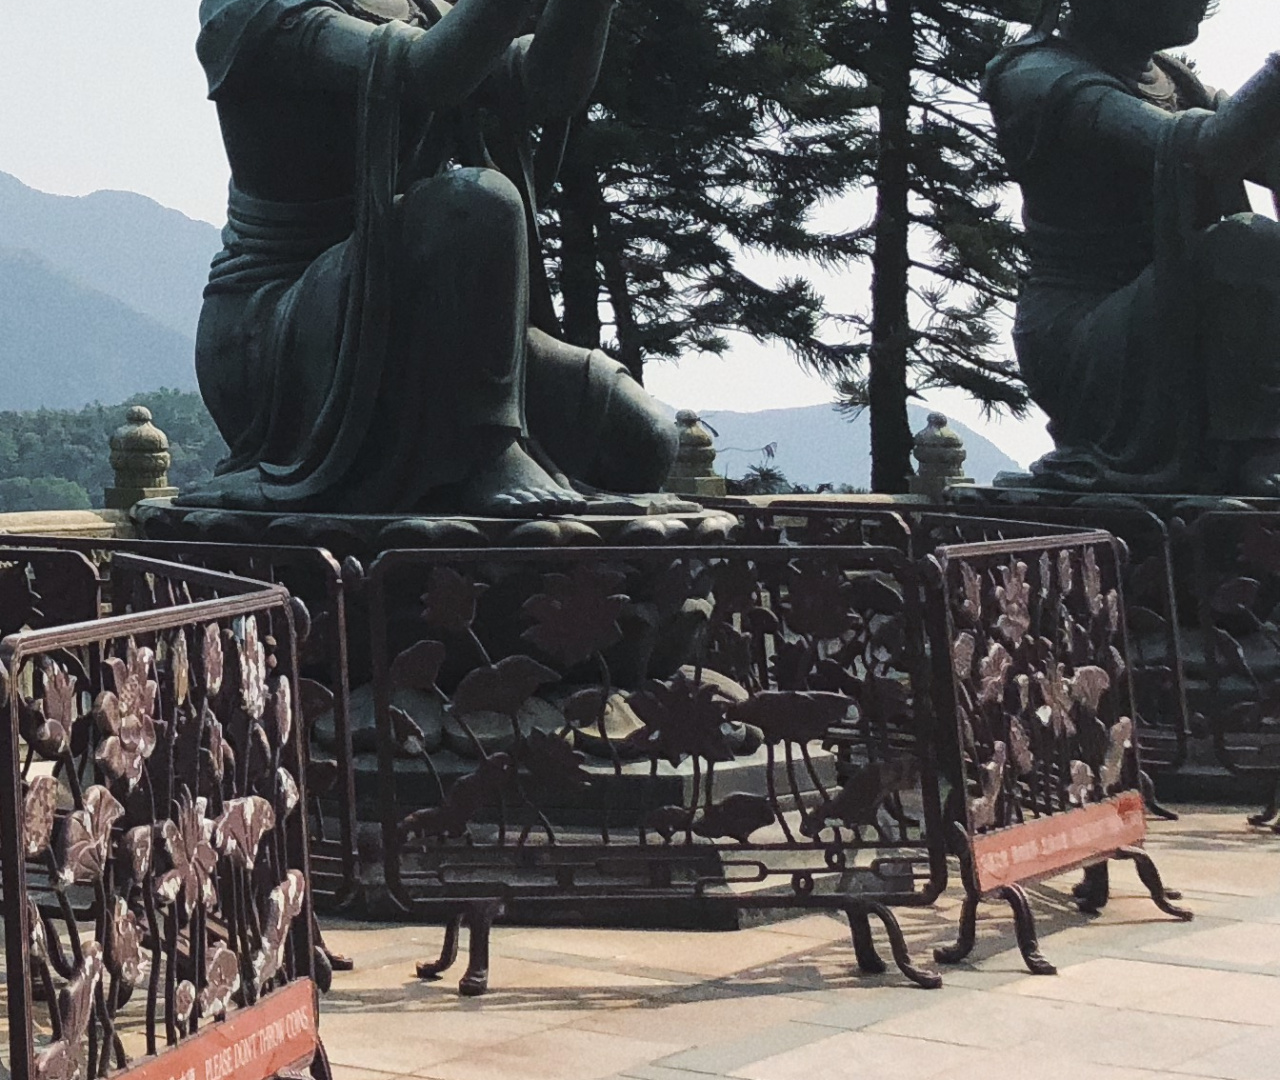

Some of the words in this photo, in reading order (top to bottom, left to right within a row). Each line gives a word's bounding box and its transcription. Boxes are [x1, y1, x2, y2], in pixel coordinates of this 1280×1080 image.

[204, 1046, 232, 1080] PLEASE
[259, 1018, 285, 1055] THROW
[285, 1006, 309, 1039] COINS
